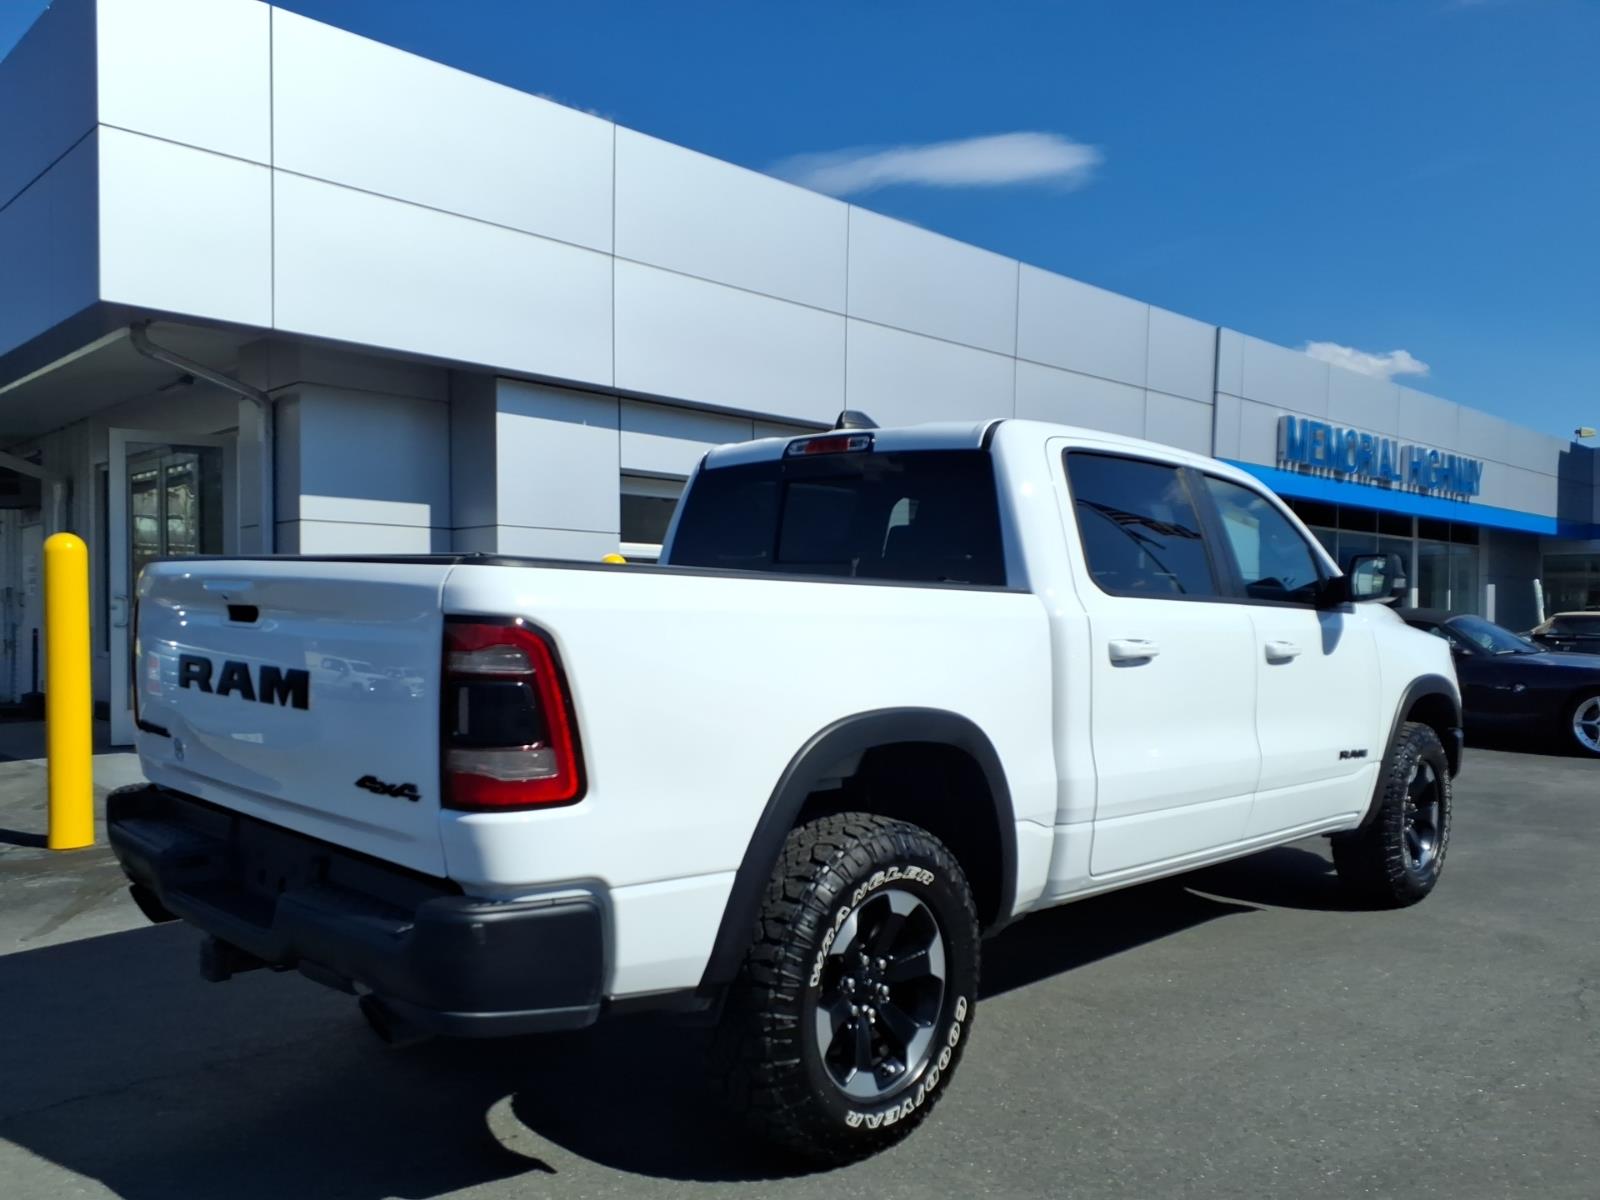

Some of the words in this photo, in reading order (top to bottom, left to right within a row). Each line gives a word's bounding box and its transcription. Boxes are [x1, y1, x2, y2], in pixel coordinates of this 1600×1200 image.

[1279, 415, 1402, 482] MEMORIAL
[1402, 445, 1483, 497] HIGHWAY
[177, 653, 310, 711] RAM
[809, 865, 935, 988] WRANGLER
[844, 995, 968, 1129] GOODYEAR
